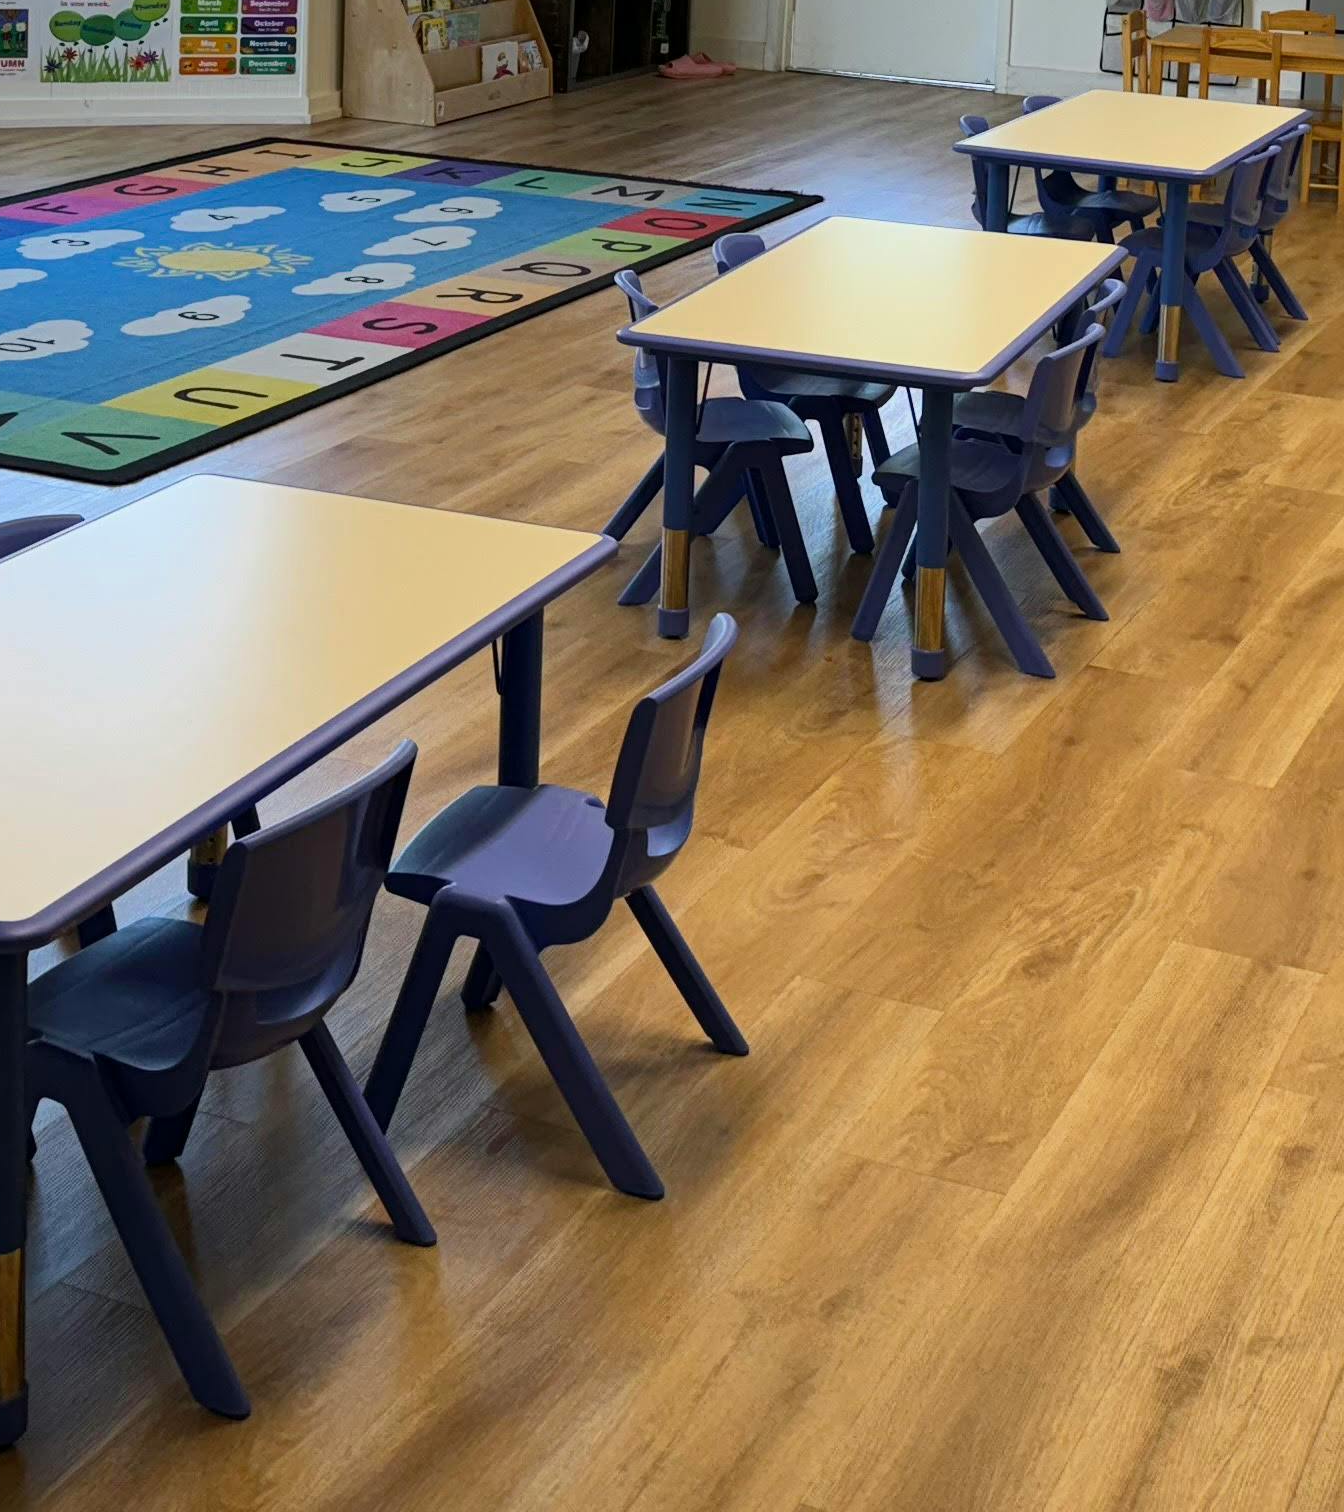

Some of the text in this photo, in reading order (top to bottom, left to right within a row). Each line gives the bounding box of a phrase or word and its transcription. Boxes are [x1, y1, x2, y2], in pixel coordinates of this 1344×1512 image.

[197, 0, 222, 7] March
[250, 0, 290, 8] September
[199, 19, 219, 27] April
[200, 40, 216, 48] May
[198, 60, 218, 68] June
[248, 60, 287, 68] December
[23, 201, 79, 216] F
[113, 183, 179, 197] G
[178, 163, 249, 177] H
[253, 149, 313, 159] I
[341, 156, 758, 211] J K L M N
[346, 194, 382, 204] 5
[439, 206, 474, 216] 6
[208, 213, 239, 222] 4
[52, 238, 91, 248] 3
[412, 237, 448, 247] 7
[344, 275, 385, 285] 8
[173, 216, 708, 410] O P Q R S T U
[177, 310, 221, 322] 9
[59, 431, 161, 457] V
